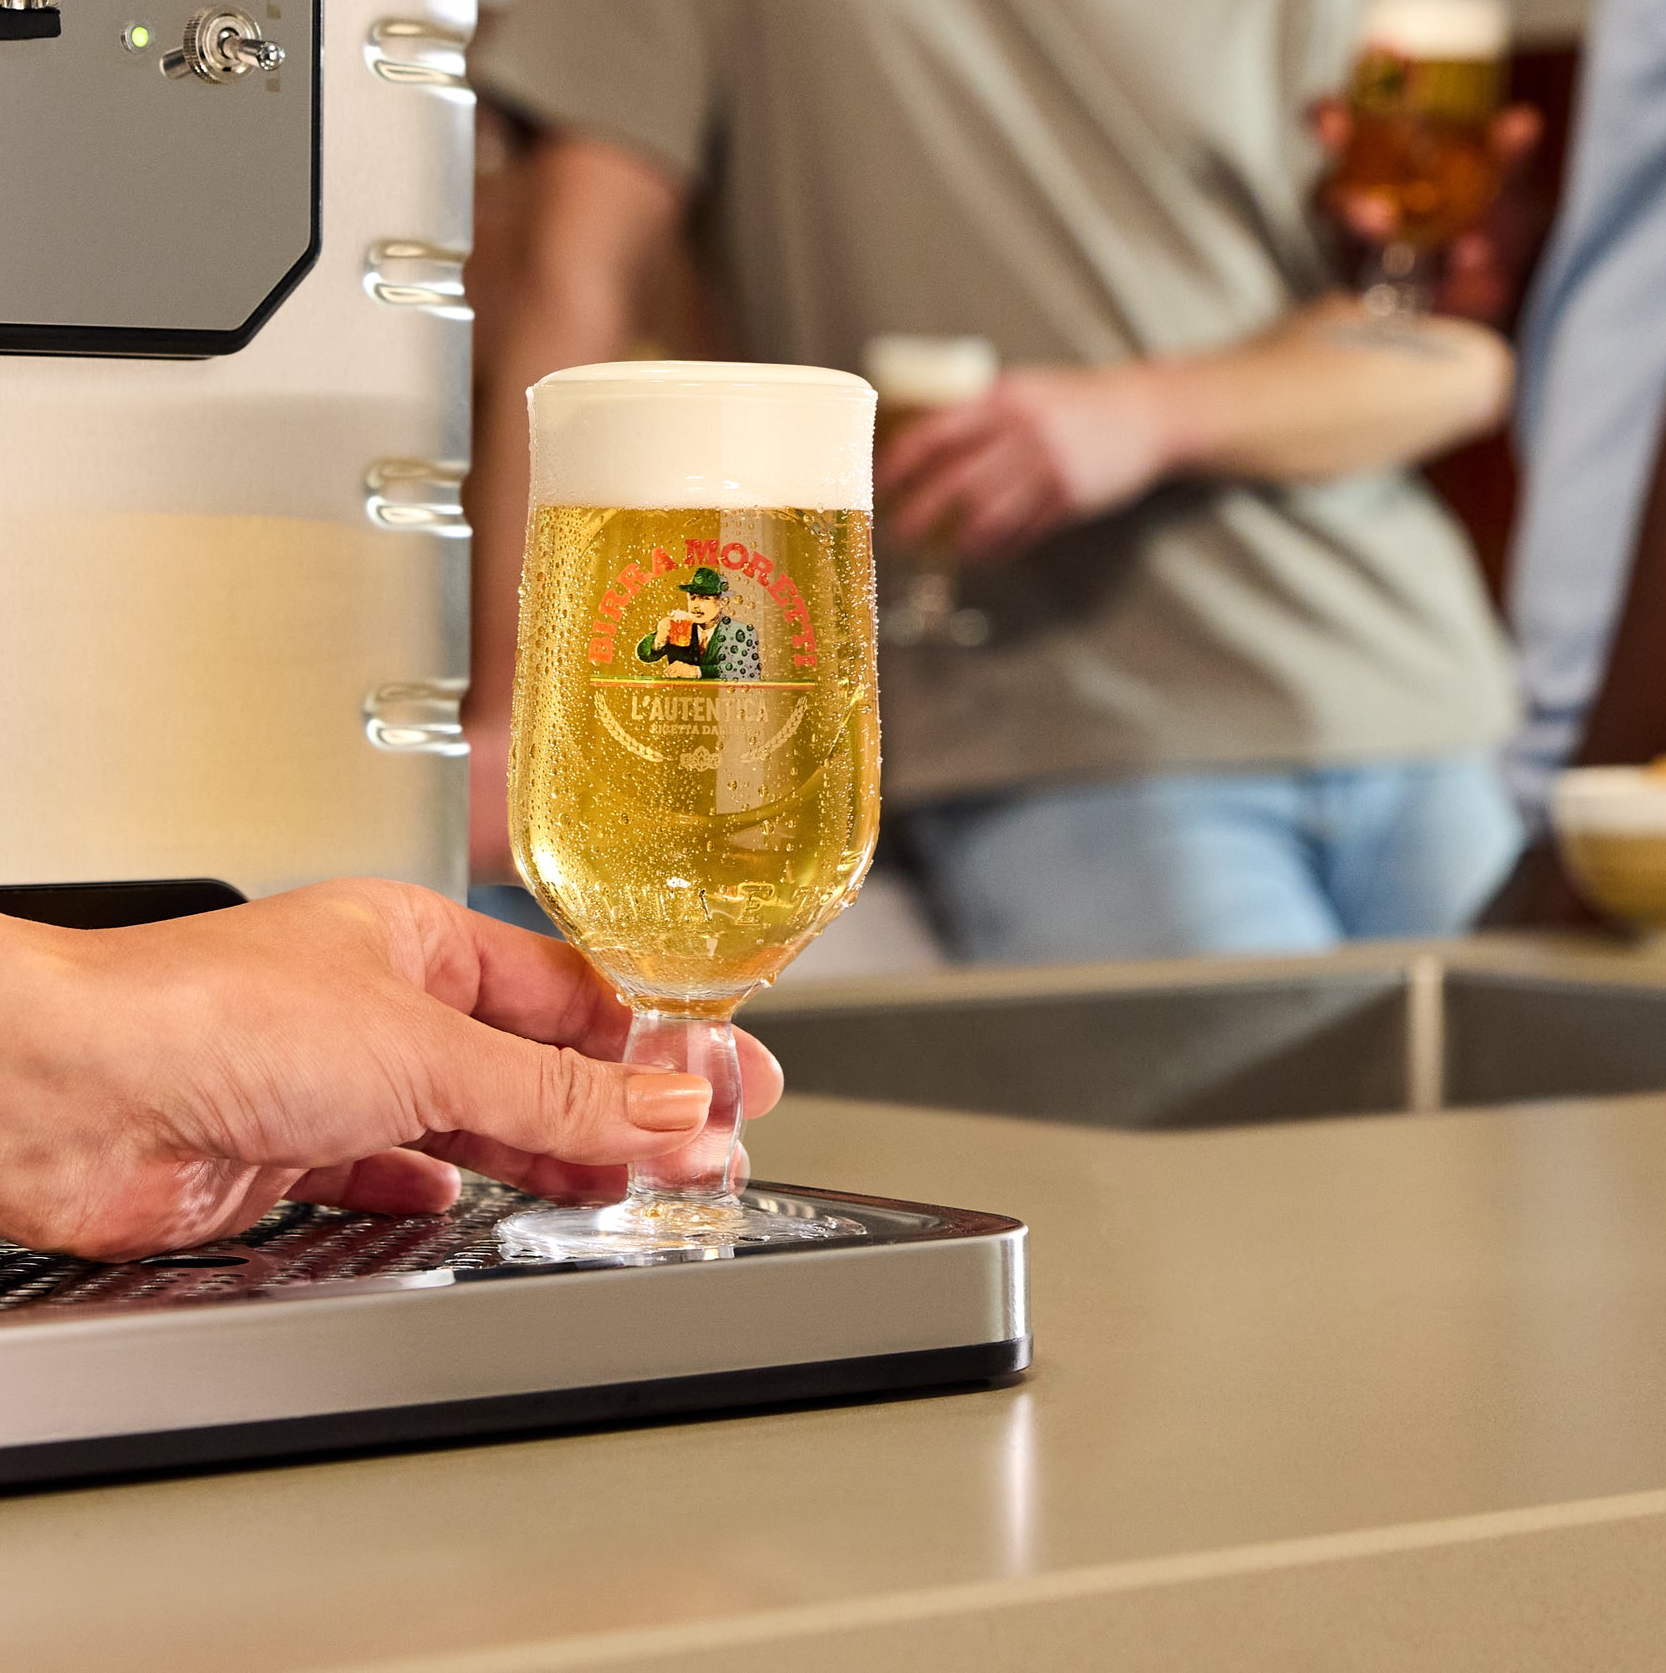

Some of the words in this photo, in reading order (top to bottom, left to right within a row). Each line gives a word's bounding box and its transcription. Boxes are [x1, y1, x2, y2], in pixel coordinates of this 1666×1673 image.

[588, 547, 678, 664] BIRRA
[684, 538, 818, 668] MORETTI
[631, 695, 769, 722] L'AUTENTICA
